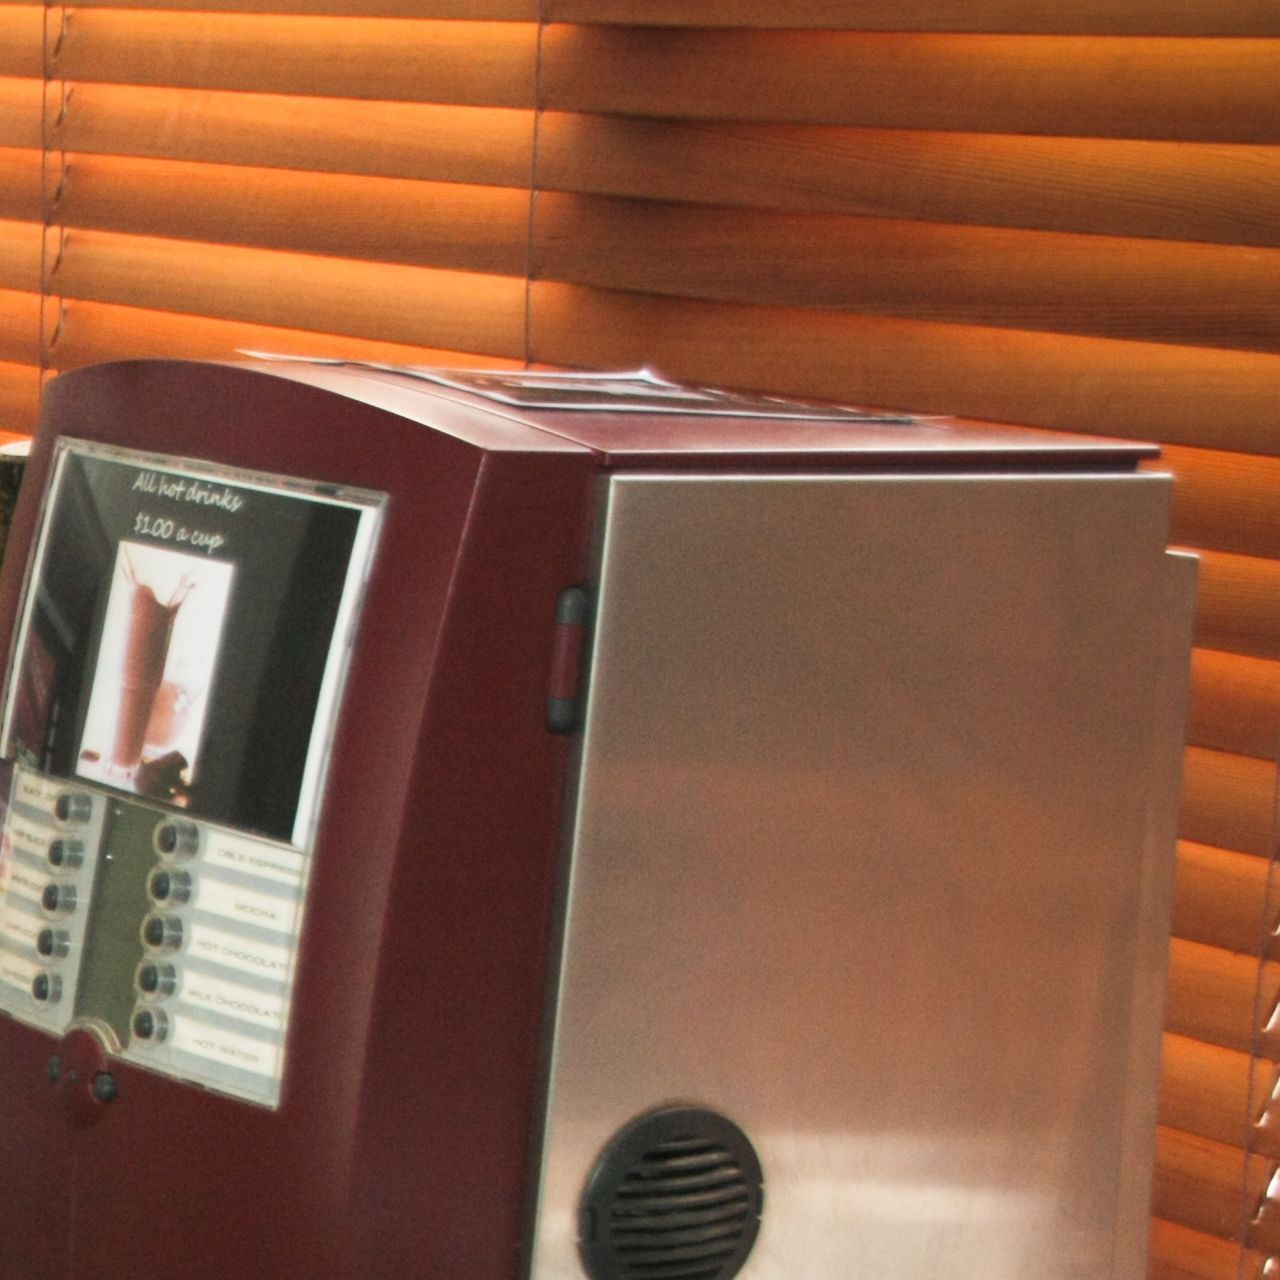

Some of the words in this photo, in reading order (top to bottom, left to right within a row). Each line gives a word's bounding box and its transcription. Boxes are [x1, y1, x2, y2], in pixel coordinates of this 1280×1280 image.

[132, 472, 156, 493] All
[158, 475, 185, 501] hot
[185, 481, 242, 513] drinks
[133, 511, 174, 540] $1.00
[176, 526, 190, 542] a
[190, 529, 225, 555] cup
[234, 902, 276, 920] MOCHA
[197, 940, 219, 951] HOT
